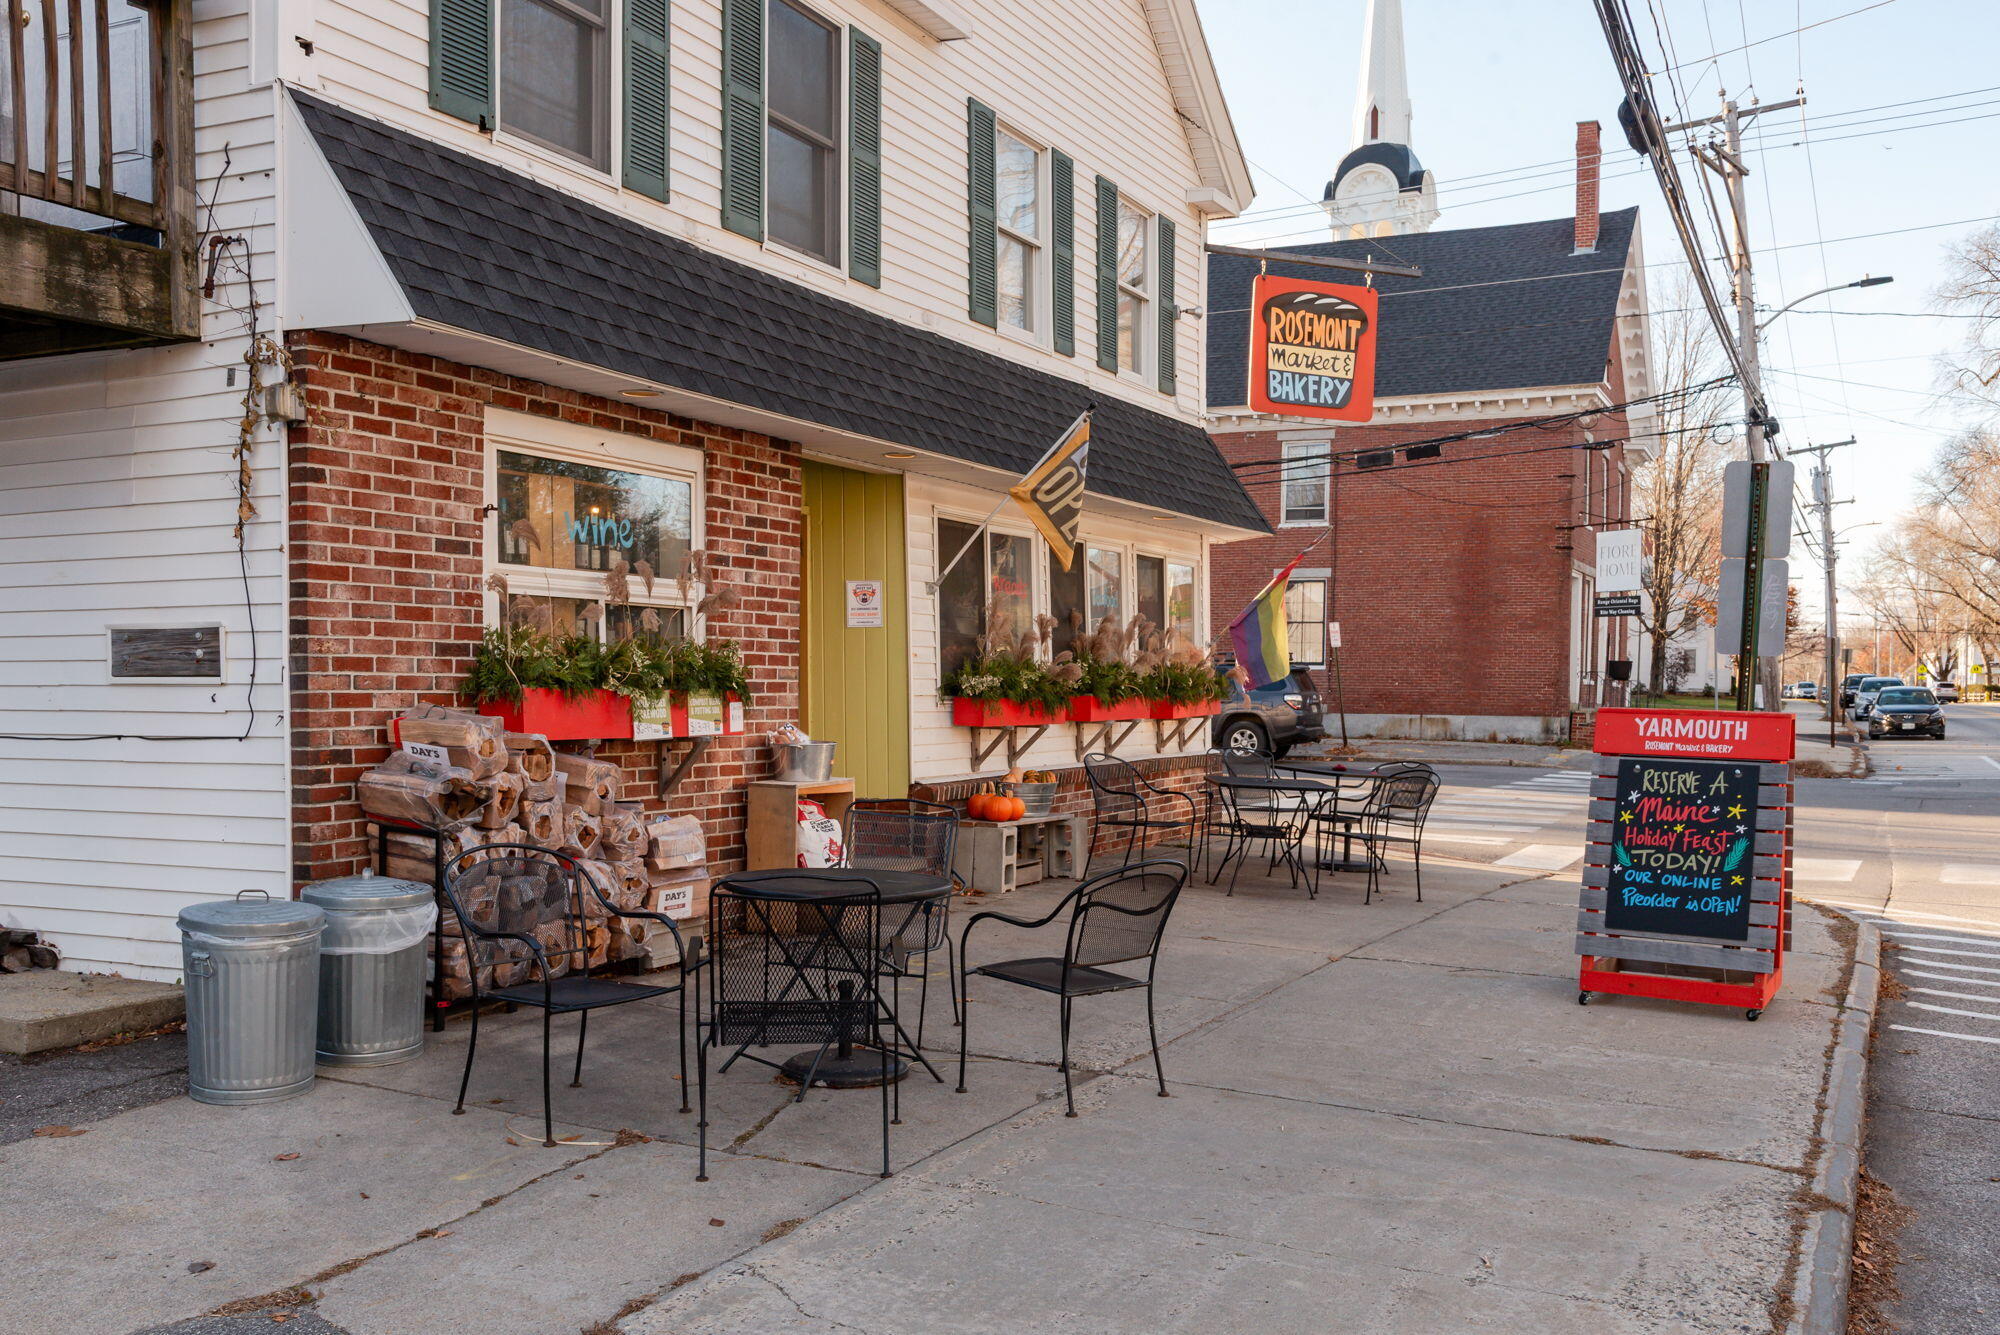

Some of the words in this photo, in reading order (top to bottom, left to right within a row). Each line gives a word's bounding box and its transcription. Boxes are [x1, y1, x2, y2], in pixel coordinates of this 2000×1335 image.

[1270, 307, 1361, 350] ROSEMONT
[1271, 347, 1341, 373] Market
[1344, 354, 1352, 376] &
[1269, 370, 1351, 404] BAKERY
[563, 511, 634, 549] wine
[1600, 562, 1637, 577] HOME
[1634, 717, 1748, 740] YARMOUTH
[1706, 743, 1733, 753] BAKERY
[1642, 768, 1701, 795] RESERVE
[1709, 770, 1729, 796] A
[1635, 797, 1720, 824] Maine
[1624, 826, 1677, 849] Holiday
[1624, 869, 1654, 884] OUR
[1661, 874, 1722, 890] ONLINE
[1622, 887, 1680, 908] Preorder
[1684, 896, 1699, 911] is
[1700, 895, 1742, 916] OPEN!
